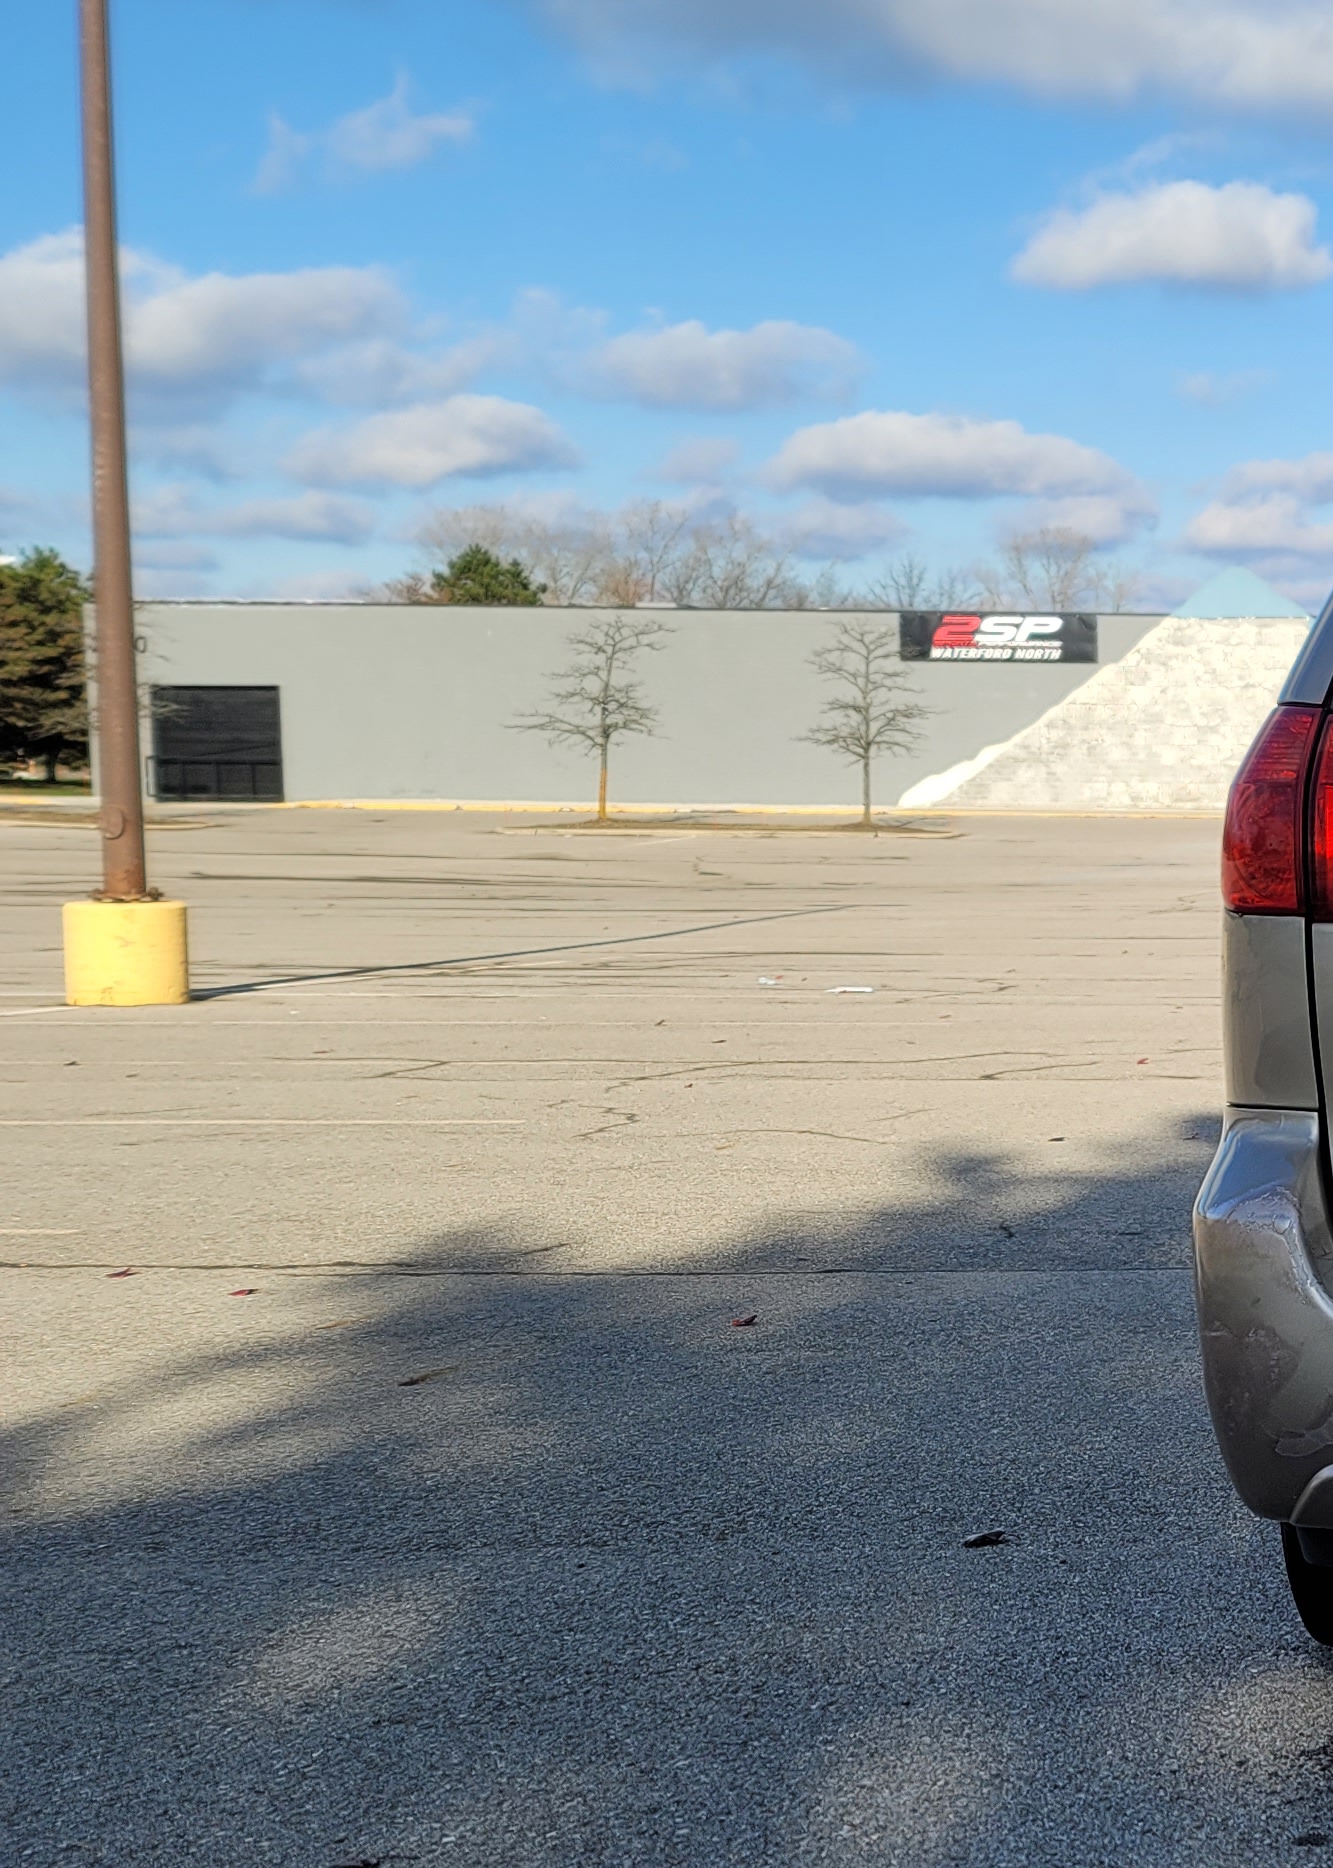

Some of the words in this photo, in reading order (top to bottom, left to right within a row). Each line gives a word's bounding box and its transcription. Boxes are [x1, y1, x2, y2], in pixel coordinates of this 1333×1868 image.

[932, 615, 1063, 641] 2SP
[930, 647, 1013, 659] WATERFORD
[1014, 647, 1062, 660] NORTH
